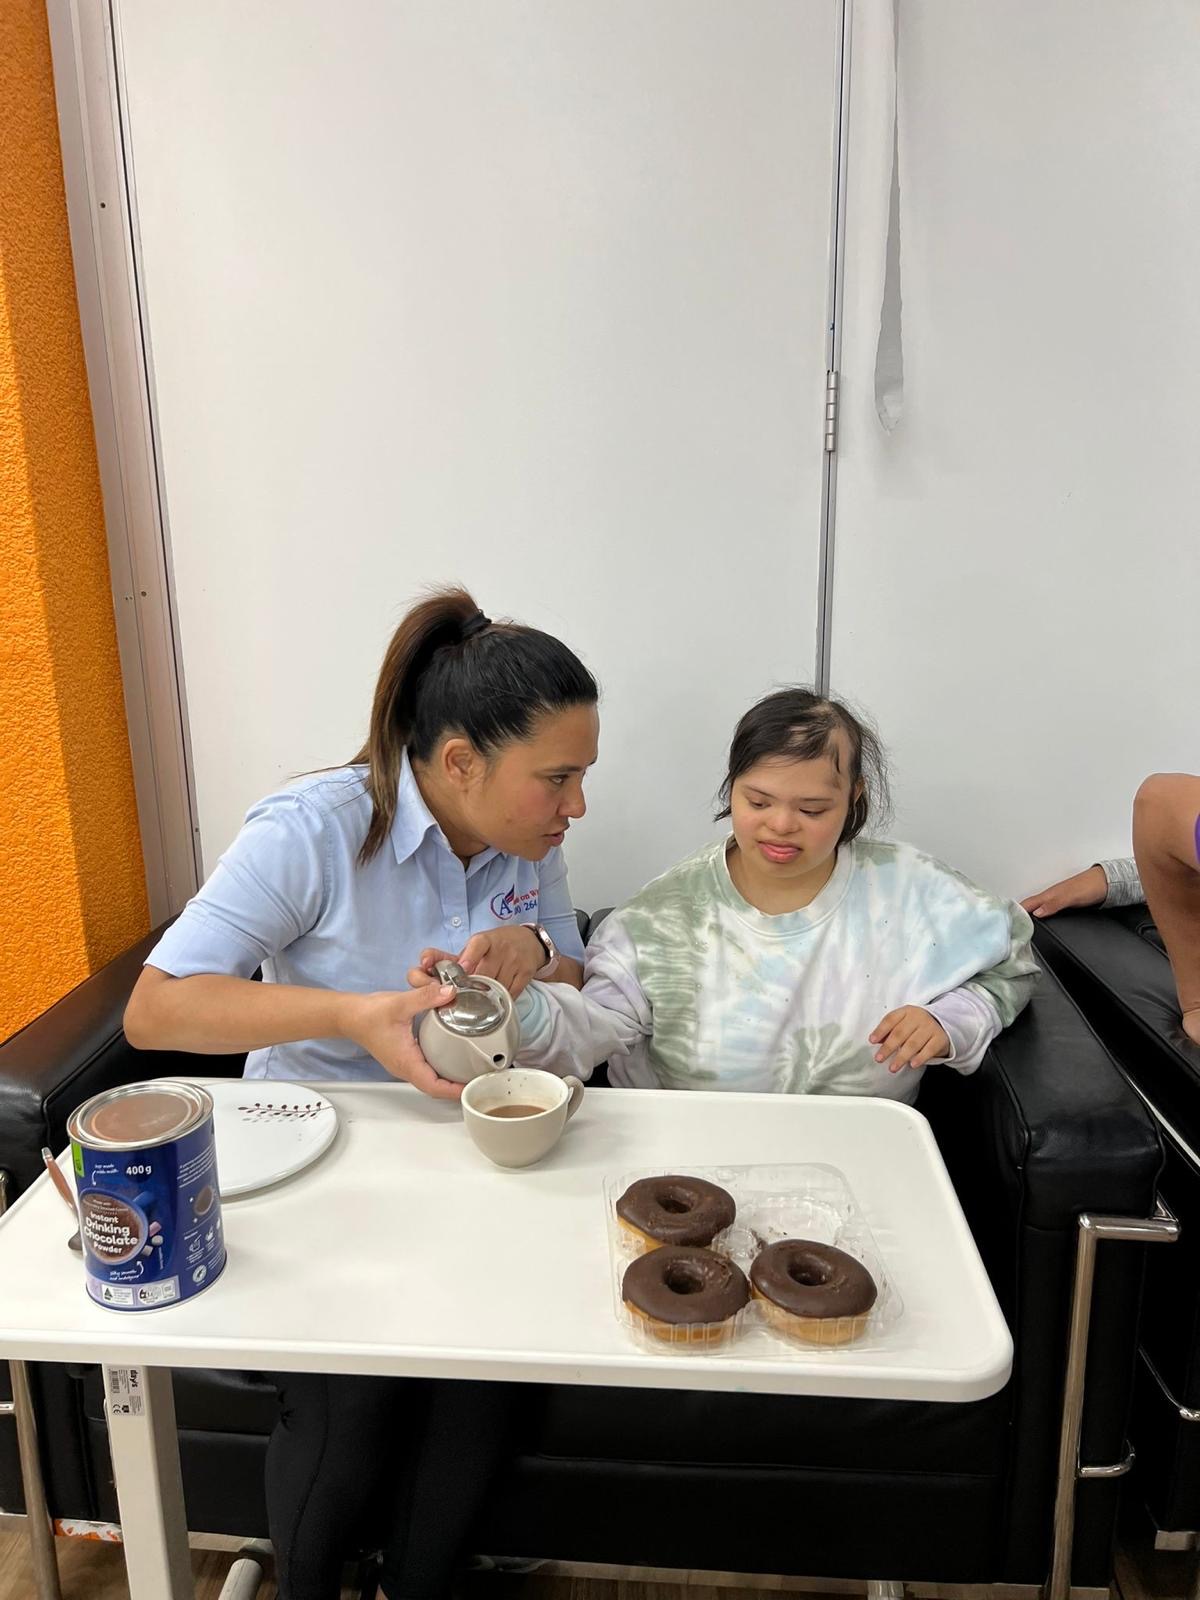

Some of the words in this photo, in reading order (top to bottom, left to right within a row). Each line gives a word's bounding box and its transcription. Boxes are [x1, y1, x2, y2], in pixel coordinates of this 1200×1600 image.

[90, 1211, 119, 1224] Instant
[86, 1217, 130, 1236] Drinking
[84, 1226, 138, 1245] Chocolate
[94, 1241, 123, 1254] Powder
